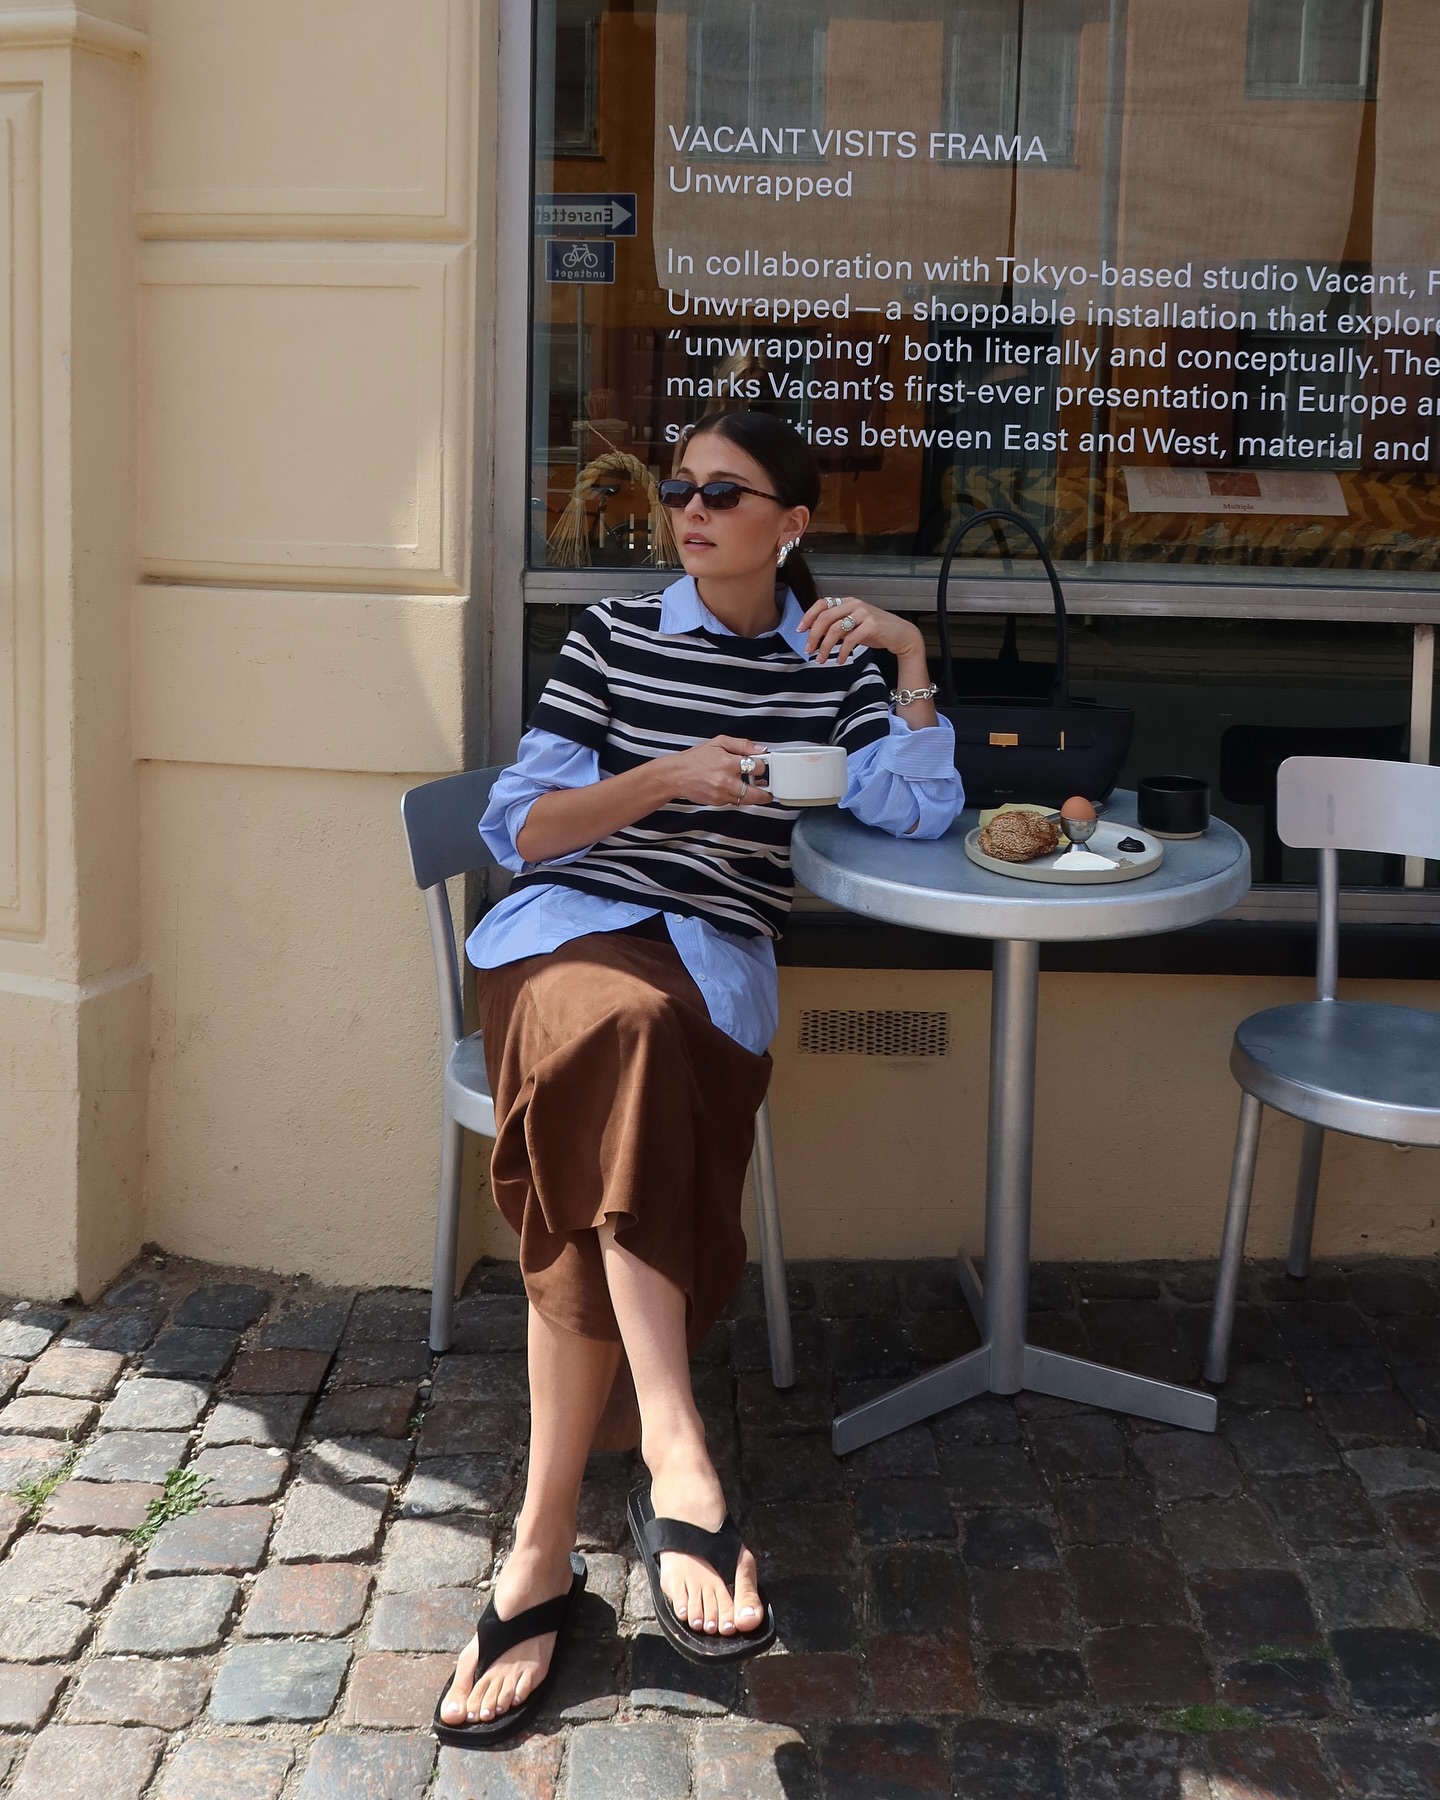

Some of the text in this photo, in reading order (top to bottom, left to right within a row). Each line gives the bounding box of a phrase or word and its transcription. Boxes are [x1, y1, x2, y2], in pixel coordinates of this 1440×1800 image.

[669, 124, 1048, 162] VACANT VISITS FRAMA
[669, 165, 853, 201] Unwrapped
[667, 247, 694, 275] In
[705, 249, 912, 280] collaboration
[923, 255, 990, 282] with
[995, 256, 1192, 291] Tokyo-based
[1202, 264, 1298, 292] studio
[1305, 265, 1416, 300] Vacant,
[913, 295, 1076, 329] shoppable
[1087, 299, 1256, 330] installation
[1267, 305, 1328, 333] that
[1337, 308, 1440, 341] explor
[904, 335, 972, 363] both
[985, 337, 1100, 372] literally
[1110, 341, 1166, 368] and
[1177, 347, 1378, 380] conceptually.
[1384, 348, 1440, 376] The
[667, 371, 1440, 420] marks Vacant’s first-ever presentation in Europe a
[860, 420, 991, 450] between
[1004, 424, 1069, 452] East
[1078, 427, 1135, 453] and
[1142, 427, 1227, 460] West,
[1239, 433, 1362, 463] material
[1373, 436, 1430, 461] and
